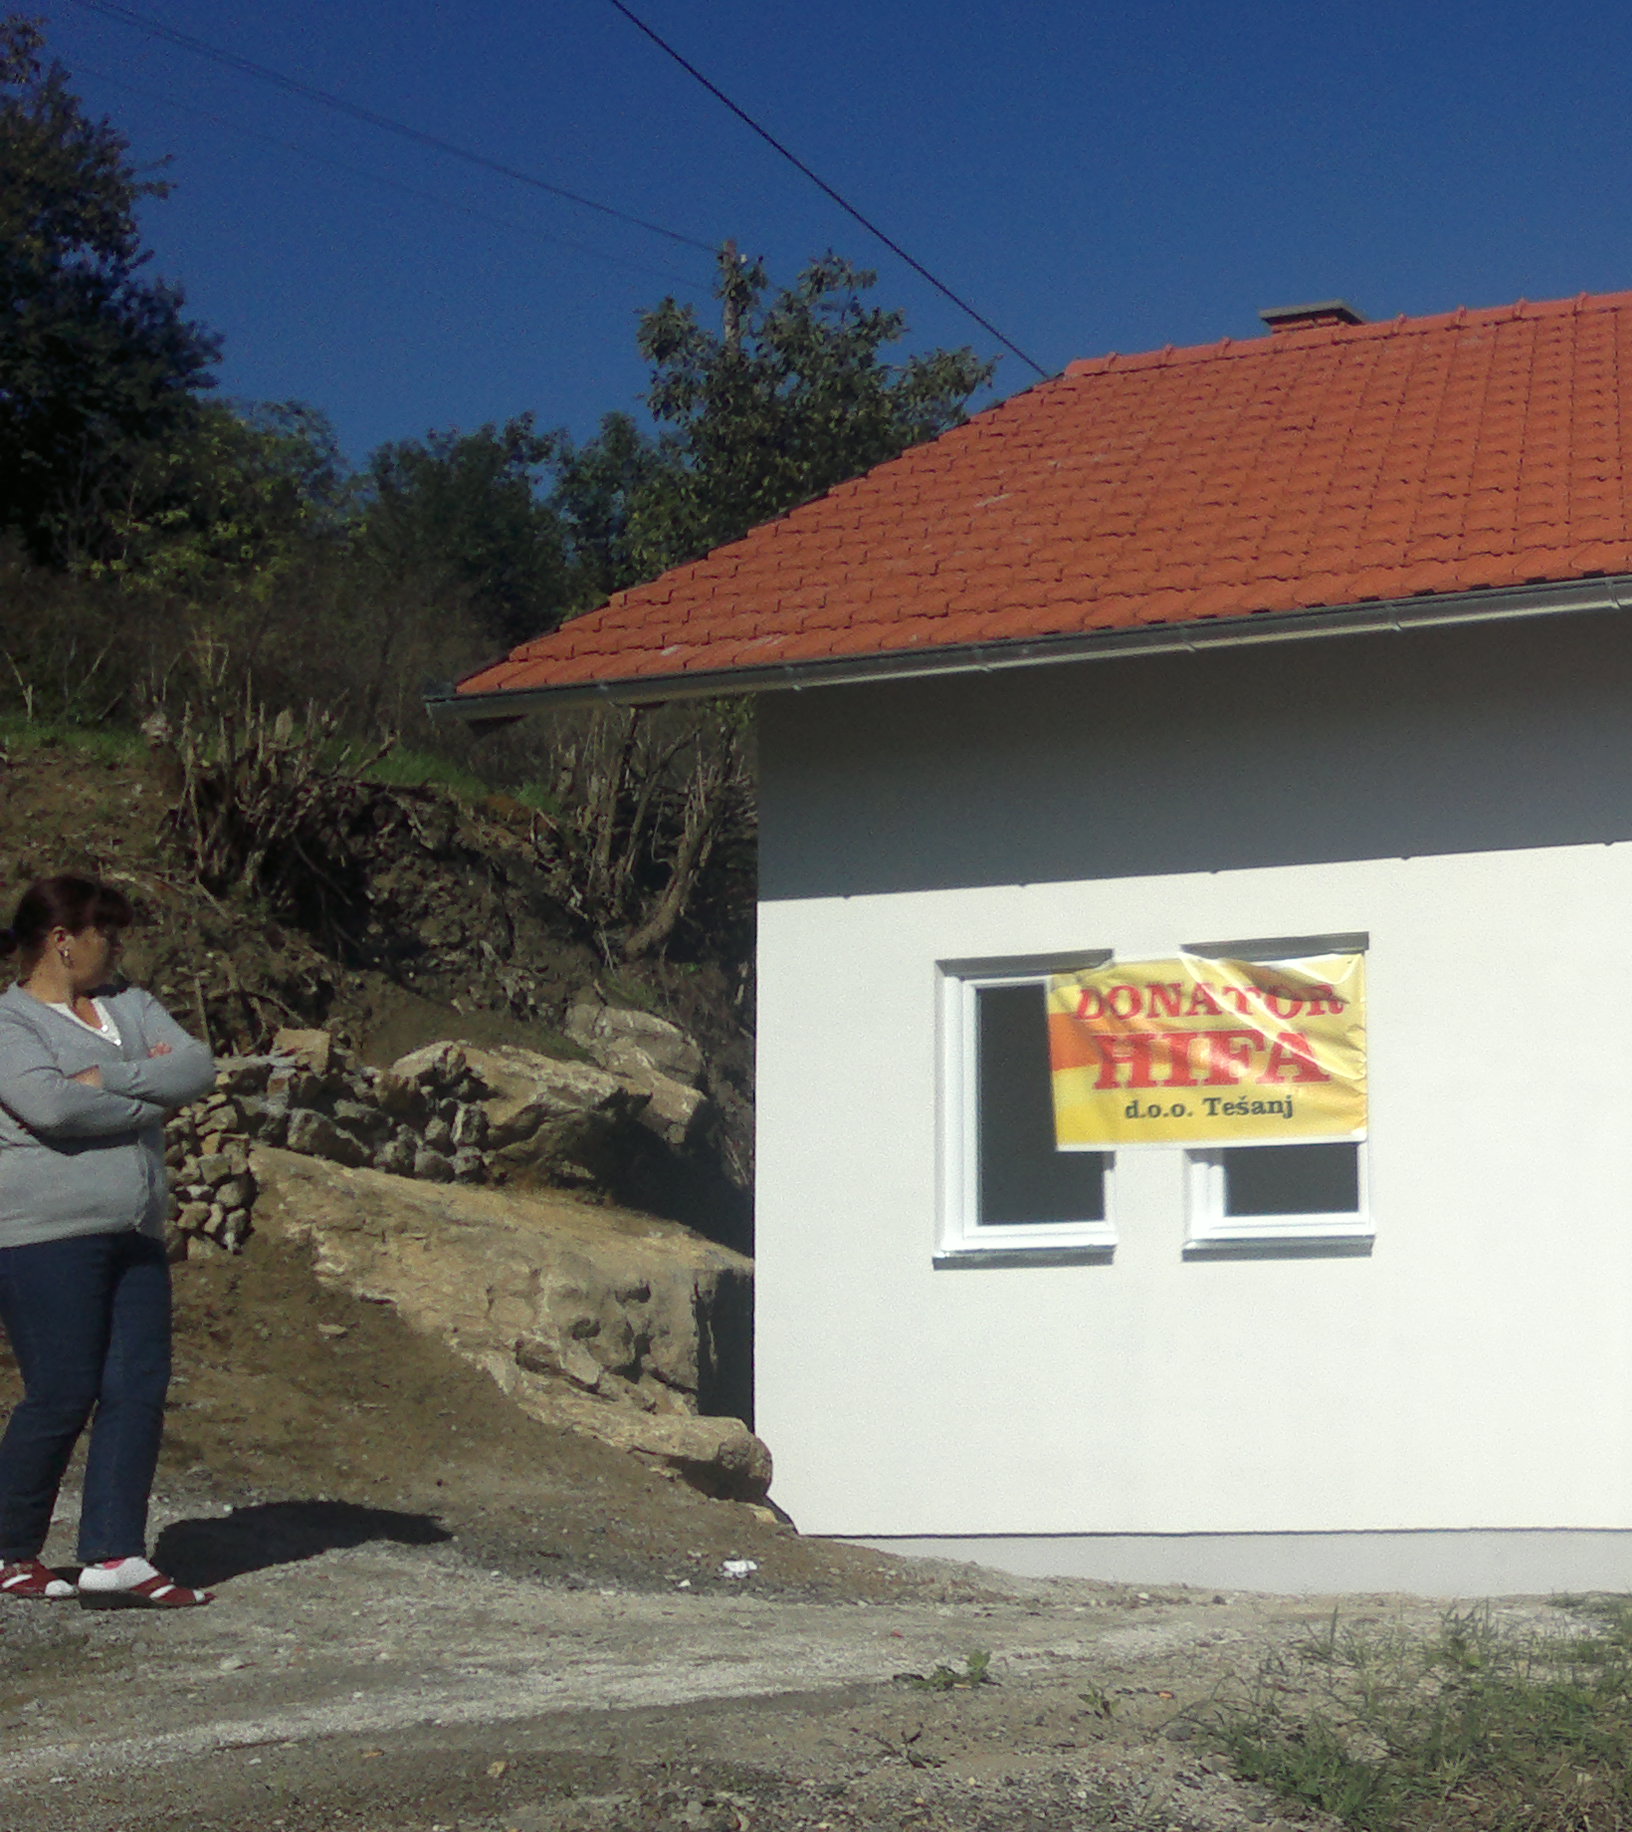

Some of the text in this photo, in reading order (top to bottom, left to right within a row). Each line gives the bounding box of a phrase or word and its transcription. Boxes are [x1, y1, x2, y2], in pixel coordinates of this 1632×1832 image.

[1075, 981, 1344, 1021] DONATOR
[1092, 1028, 1332, 1090] HIFA
[1125, 1095, 1294, 1119] d.o.o. Tešanj
